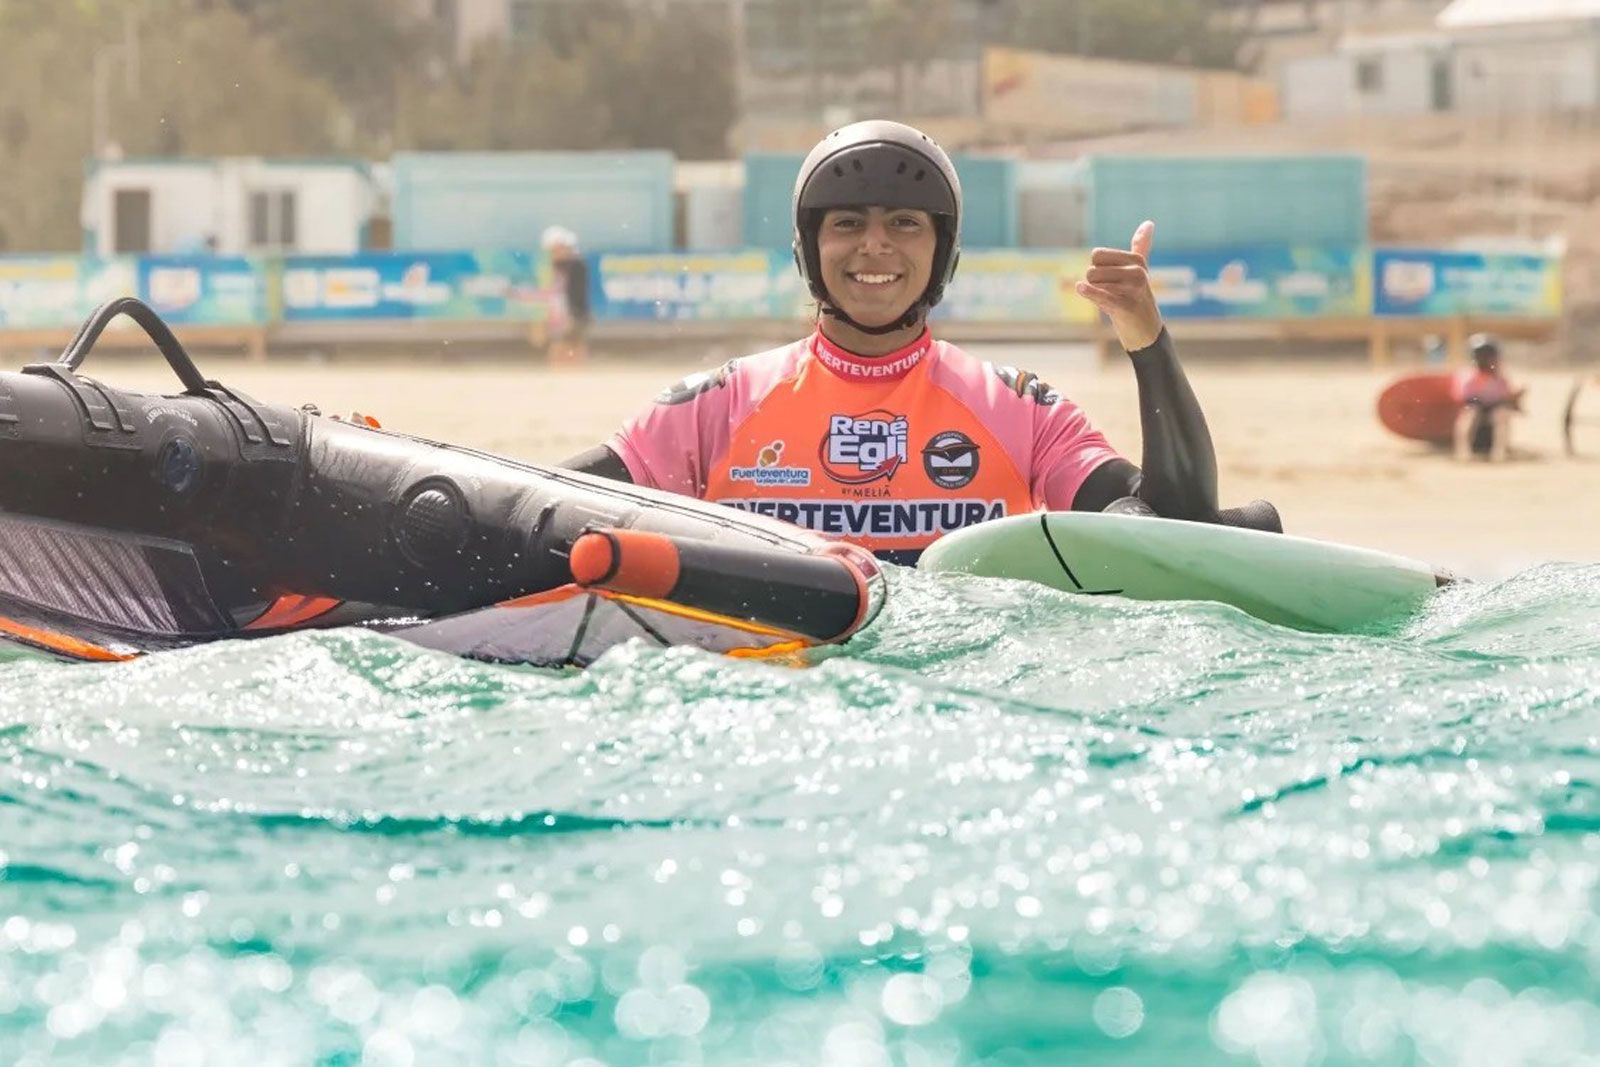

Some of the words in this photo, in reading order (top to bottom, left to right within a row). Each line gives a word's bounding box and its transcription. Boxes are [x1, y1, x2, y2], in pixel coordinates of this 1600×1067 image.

[829, 414, 908, 436] René
[829, 435, 908, 471] Egli
[731, 468, 809, 479] Fuerteventura
